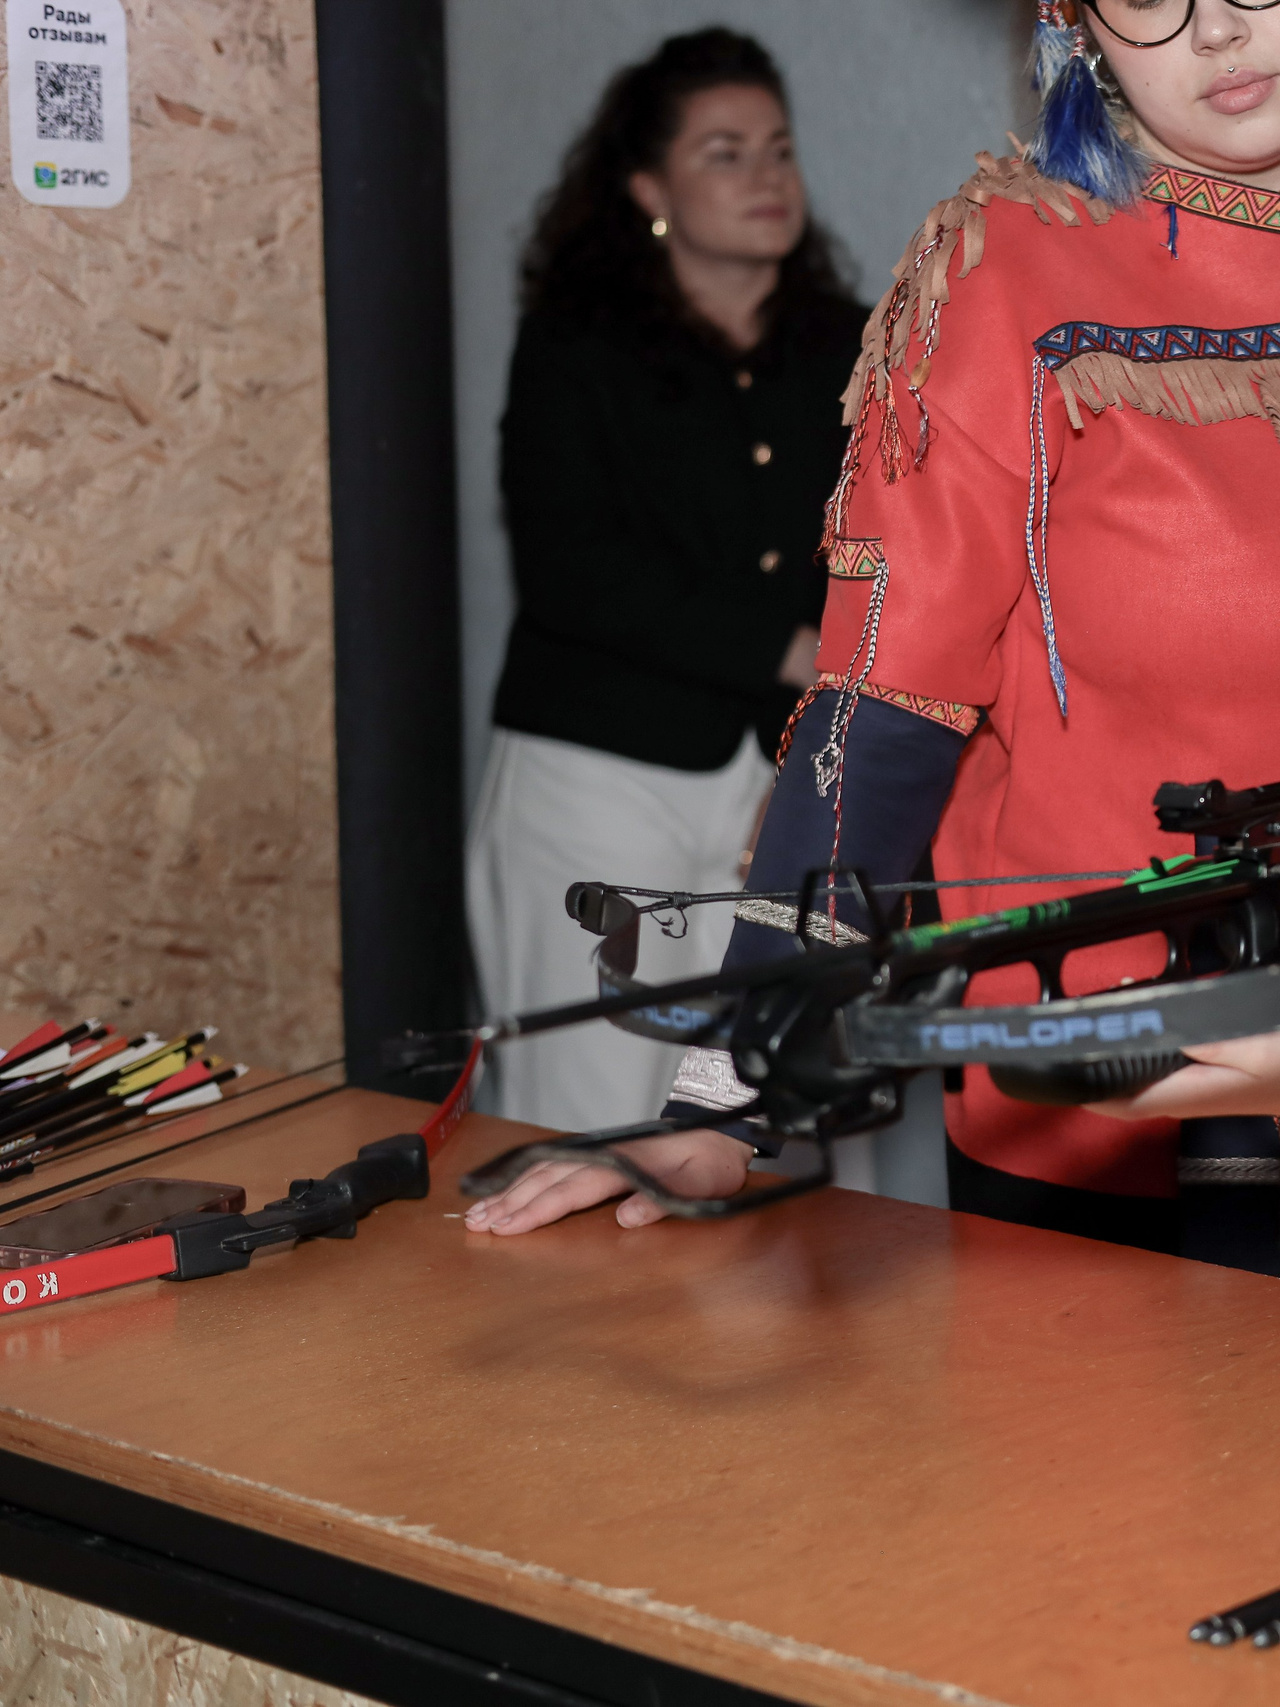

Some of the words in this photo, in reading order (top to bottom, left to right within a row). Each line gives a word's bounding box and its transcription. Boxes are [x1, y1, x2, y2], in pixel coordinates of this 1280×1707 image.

[43, 4, 91, 24] Рады
[28, 26, 107, 45] отзывам
[61, 168, 110, 187] 2ГИС
[919, 1009, 1165, 1051] TERLOPER
